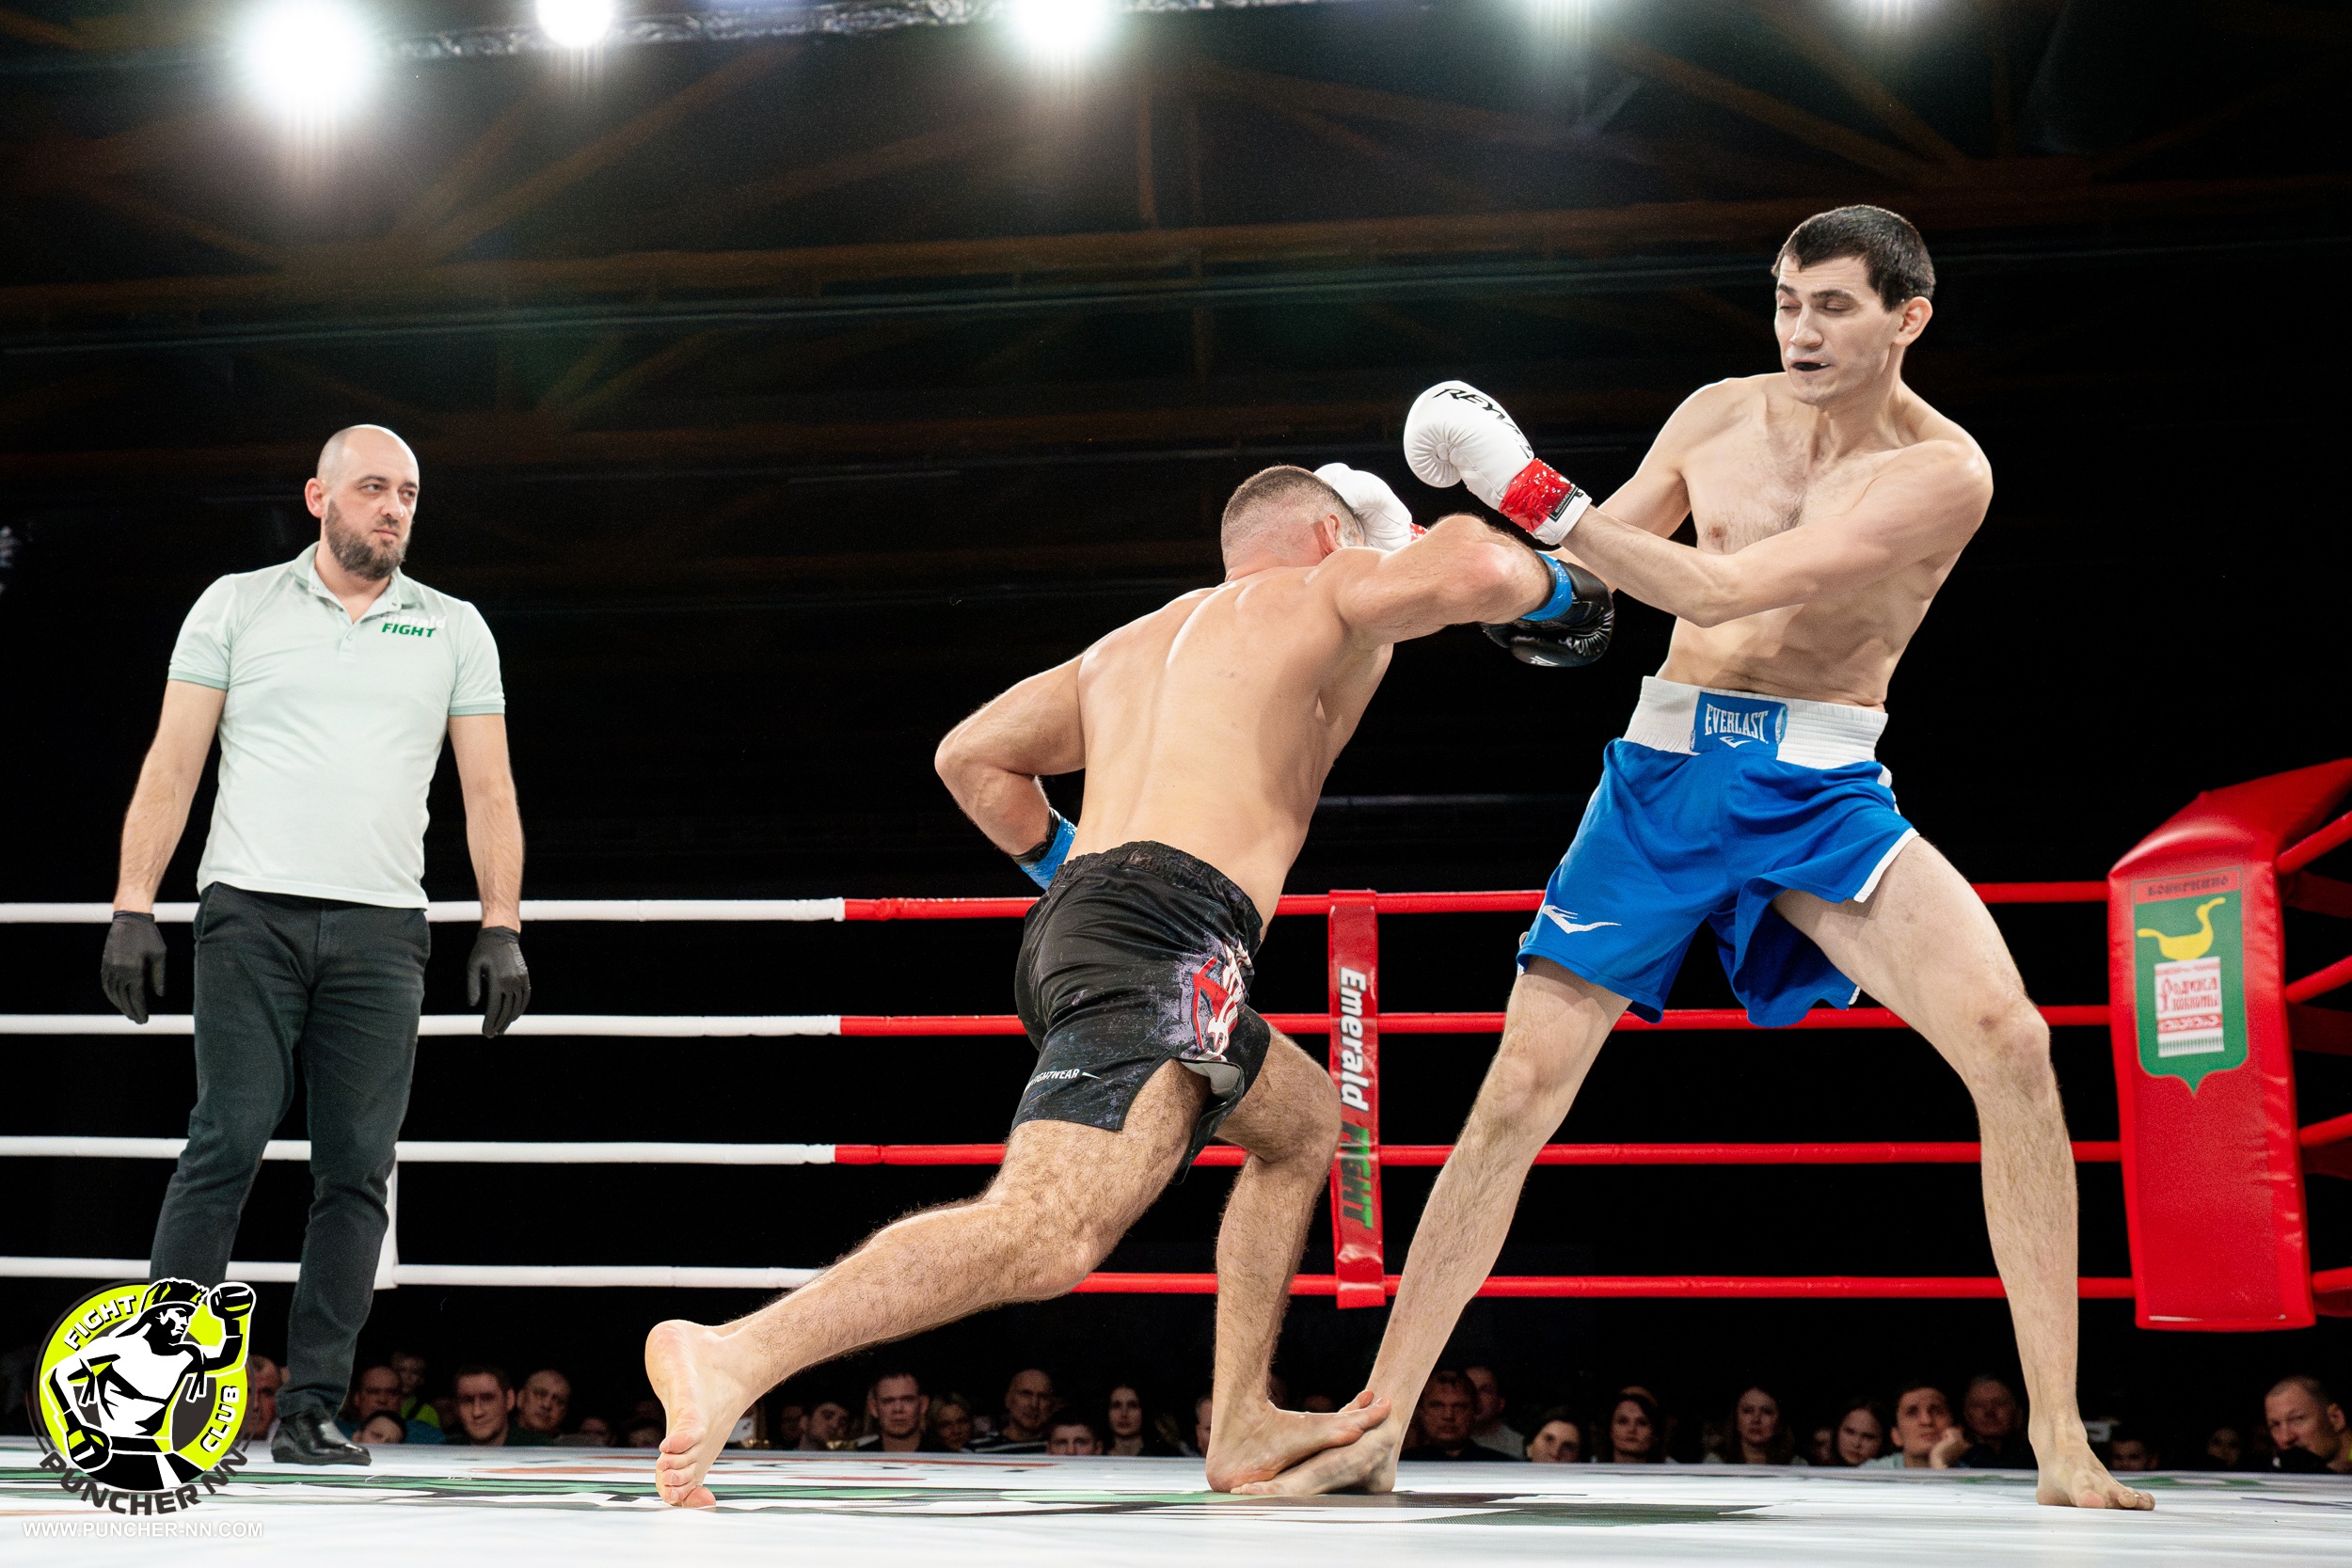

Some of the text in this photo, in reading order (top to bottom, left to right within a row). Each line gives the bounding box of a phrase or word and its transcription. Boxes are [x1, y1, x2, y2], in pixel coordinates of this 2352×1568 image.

[382, 623, 437, 638] FIGHT
[1705, 703, 1769, 743] EVERLAST
[1339, 966, 1373, 1229] Emerald FIGHT
